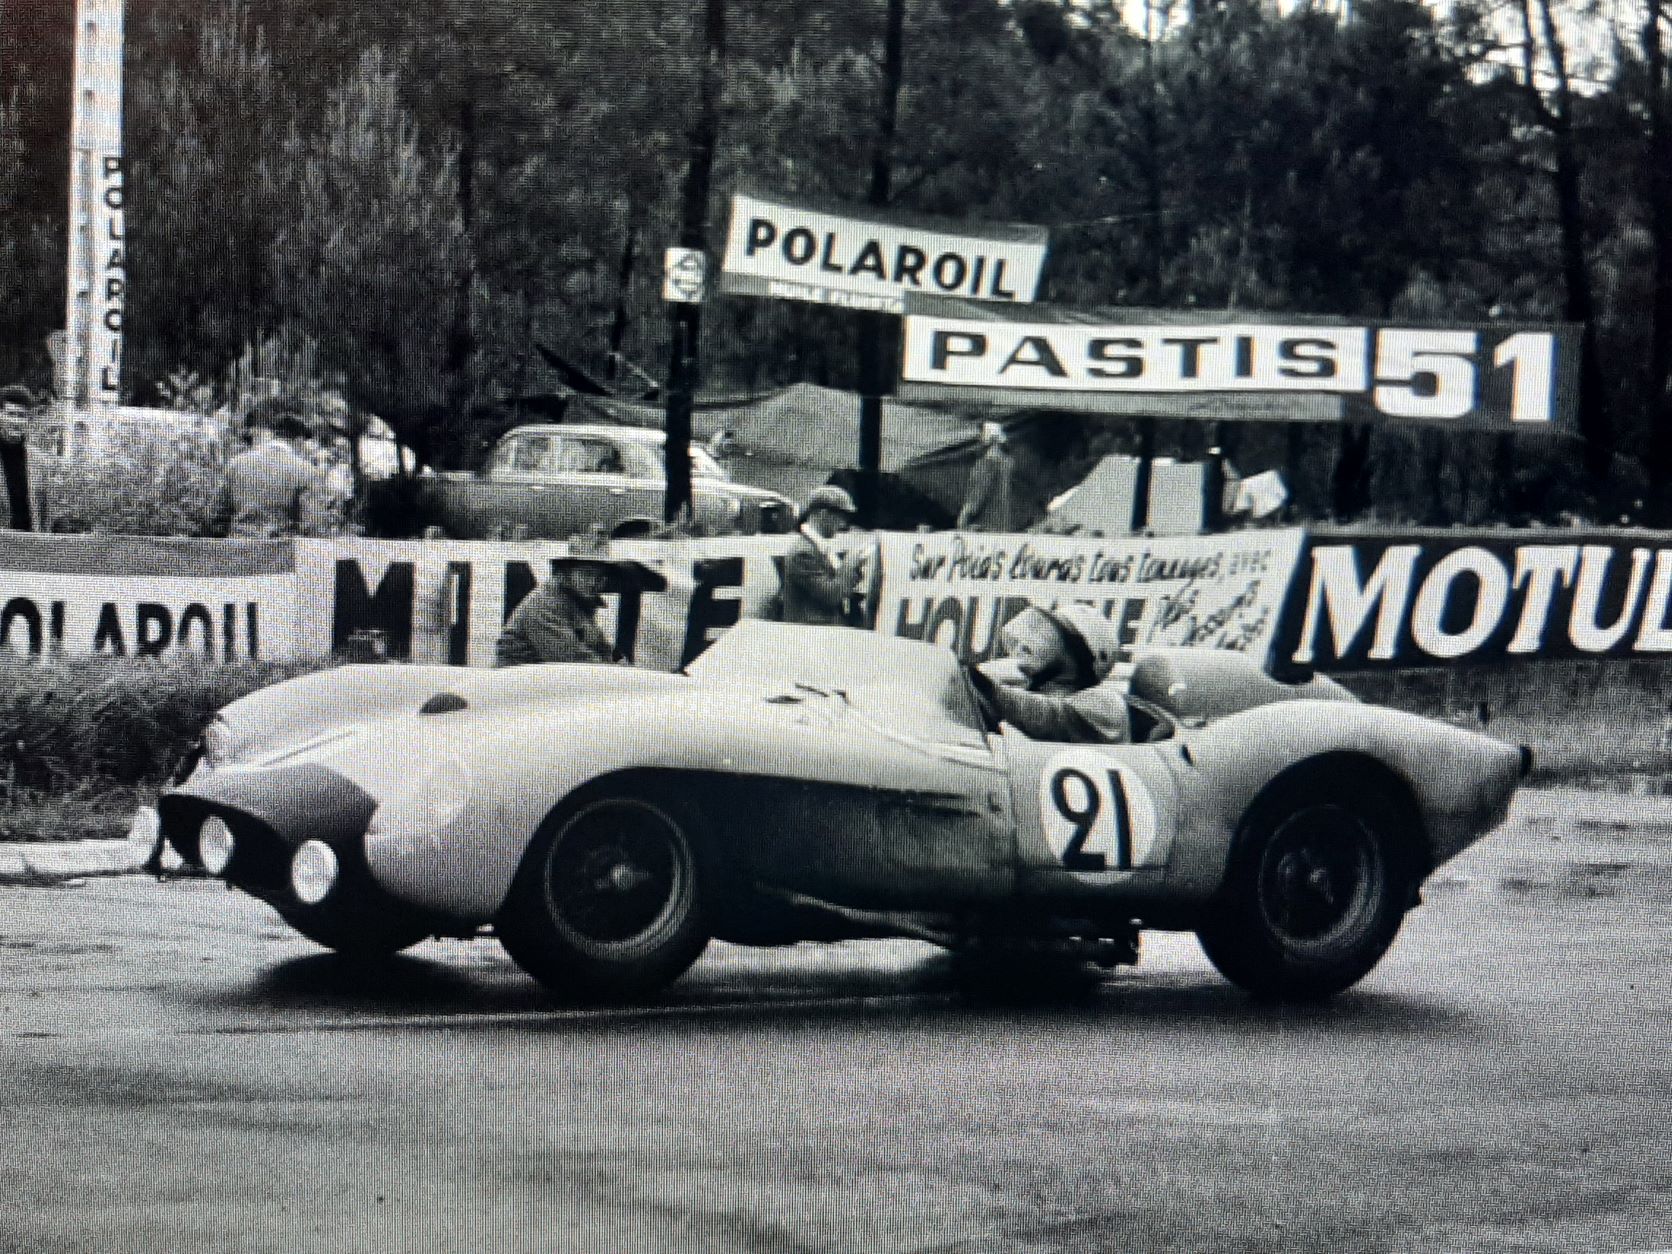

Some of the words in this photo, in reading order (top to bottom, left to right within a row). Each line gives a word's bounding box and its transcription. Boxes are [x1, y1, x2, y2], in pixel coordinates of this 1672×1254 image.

[103, 156, 123, 391] POLAROIL
[746, 218, 1015, 299] POLAROIL
[930, 329, 1339, 378] PASTIS
[1374, 328, 1556, 422] 51
[331, 556, 860, 674] MITE
[1292, 544, 1672, 663] MOTUL
[1051, 768, 1132, 872] 21
